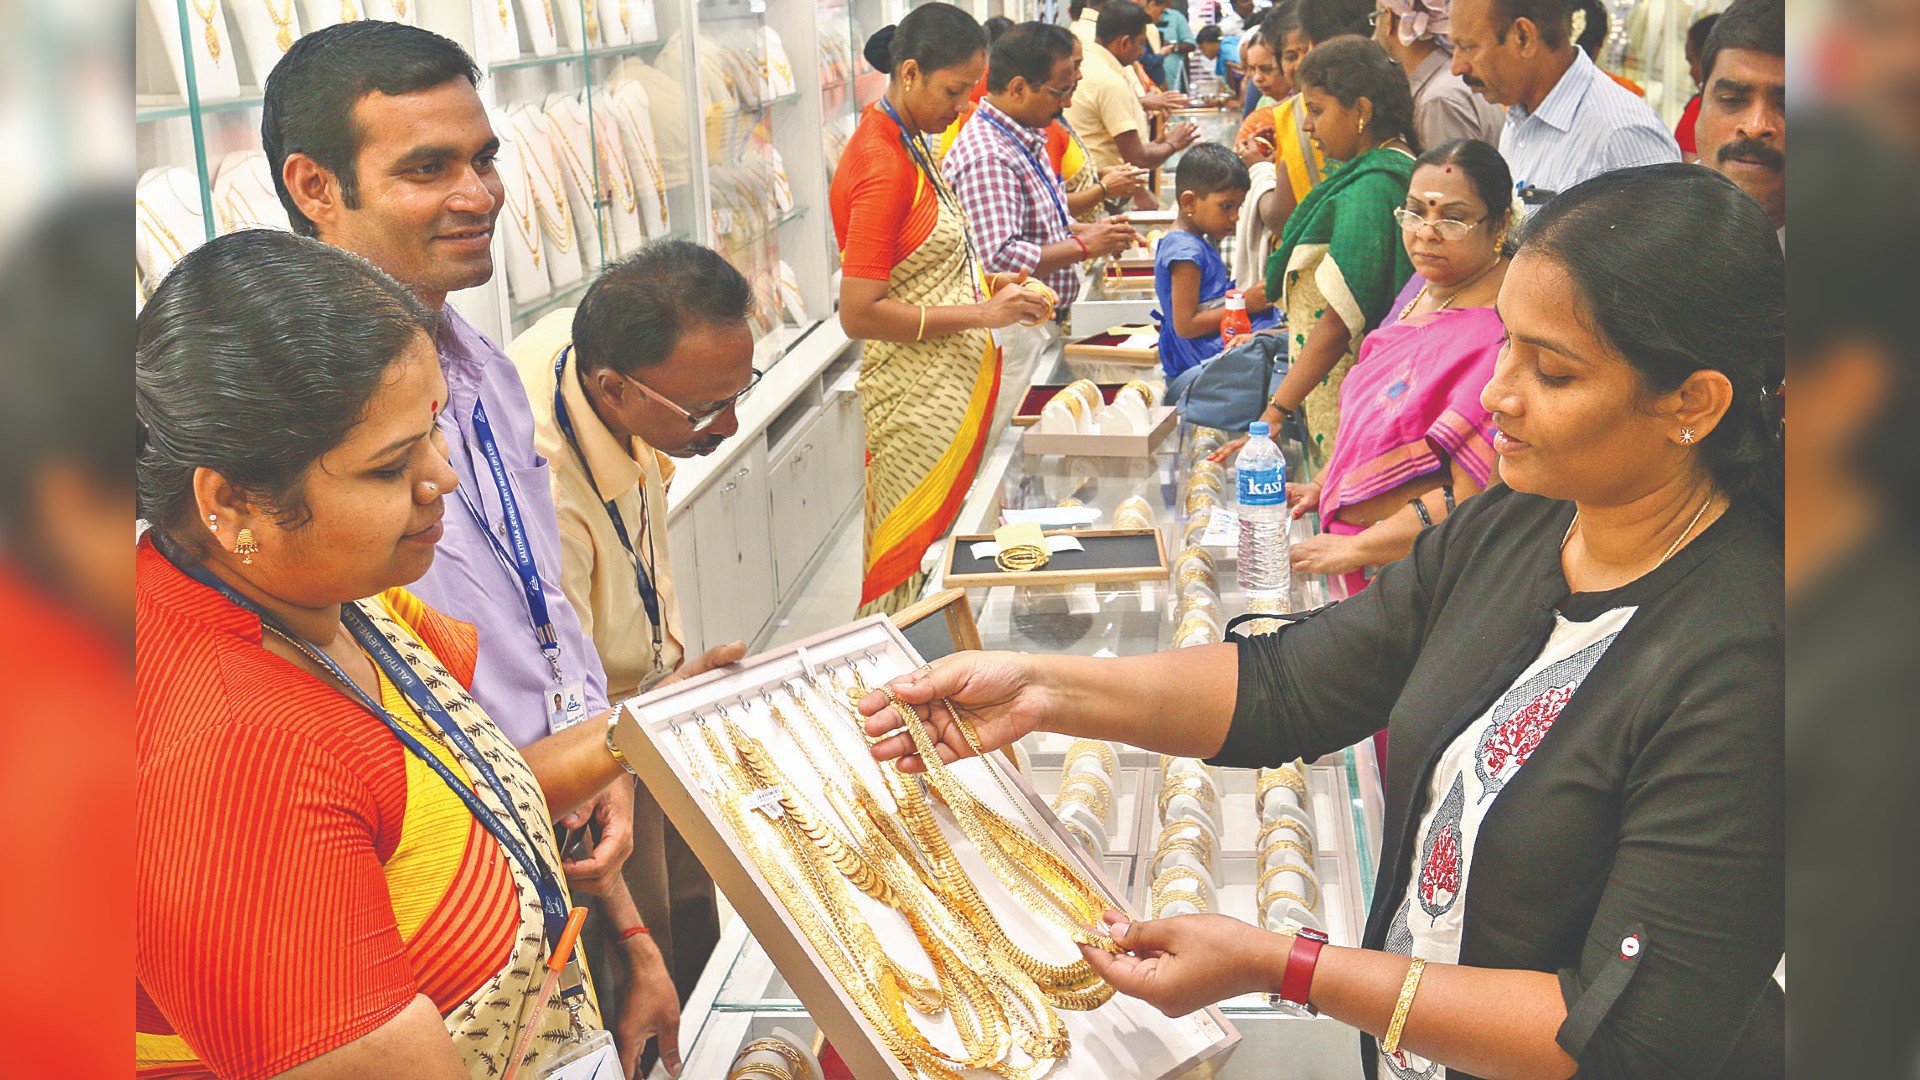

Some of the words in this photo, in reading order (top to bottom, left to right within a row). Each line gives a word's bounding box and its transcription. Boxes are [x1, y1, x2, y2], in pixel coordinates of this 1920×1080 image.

[486, 442, 495, 456] LTD
[492, 456, 500, 466] (P)
[495, 467, 506, 487] MART
[502, 488, 519, 528] JEWELLERY
[513, 529, 528, 563] LALITHAA
[378, 647, 413, 685] LALITHAA
[454, 734, 469, 749] LTD
[423, 751, 438, 766] LTD
[478, 761, 496, 783] MART
[449, 777, 471, 798] MART
[470, 799, 512, 842] JEWELLERY
[512, 842, 539, 882] LALITHAA
